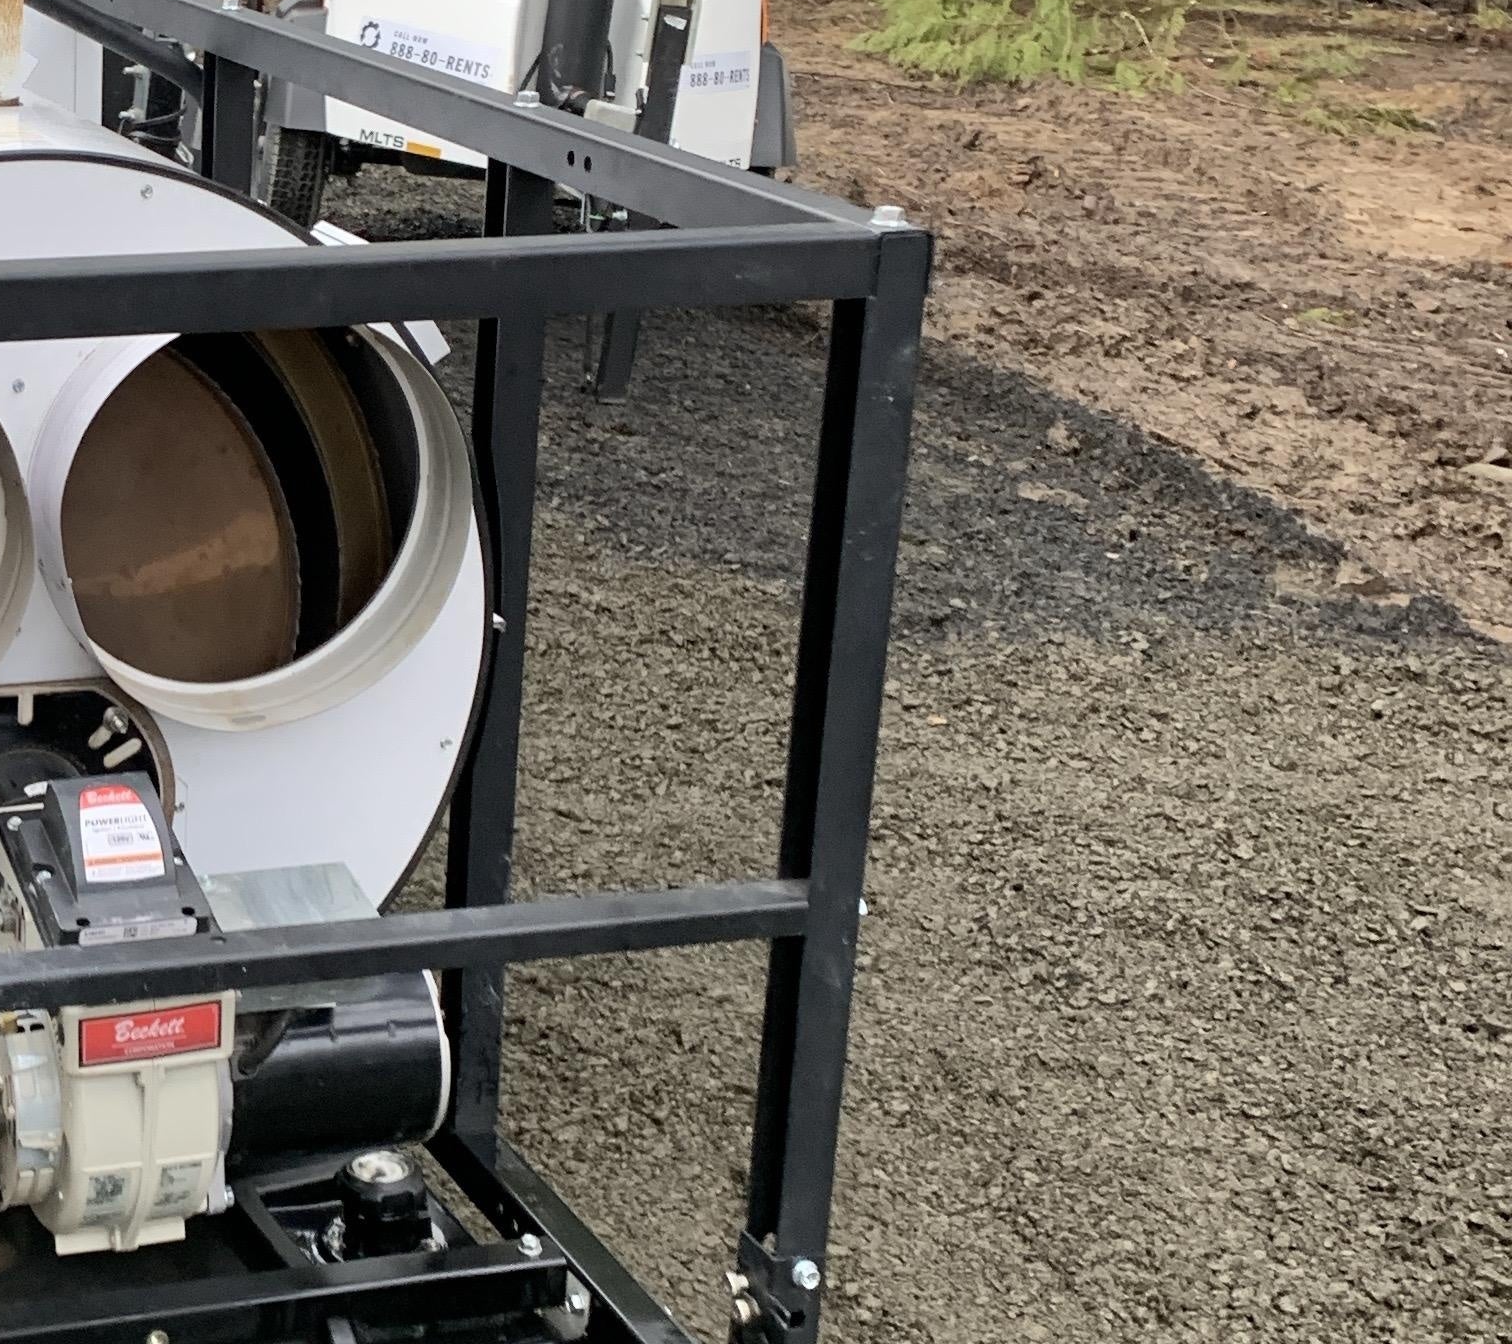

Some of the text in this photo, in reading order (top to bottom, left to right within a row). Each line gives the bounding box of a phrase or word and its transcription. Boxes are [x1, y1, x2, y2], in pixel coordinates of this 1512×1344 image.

[389, 41, 492, 79] 888-80-RENTS
[359, 128, 405, 149] MLTS
[114, 1016, 185, 1043] Beckett
